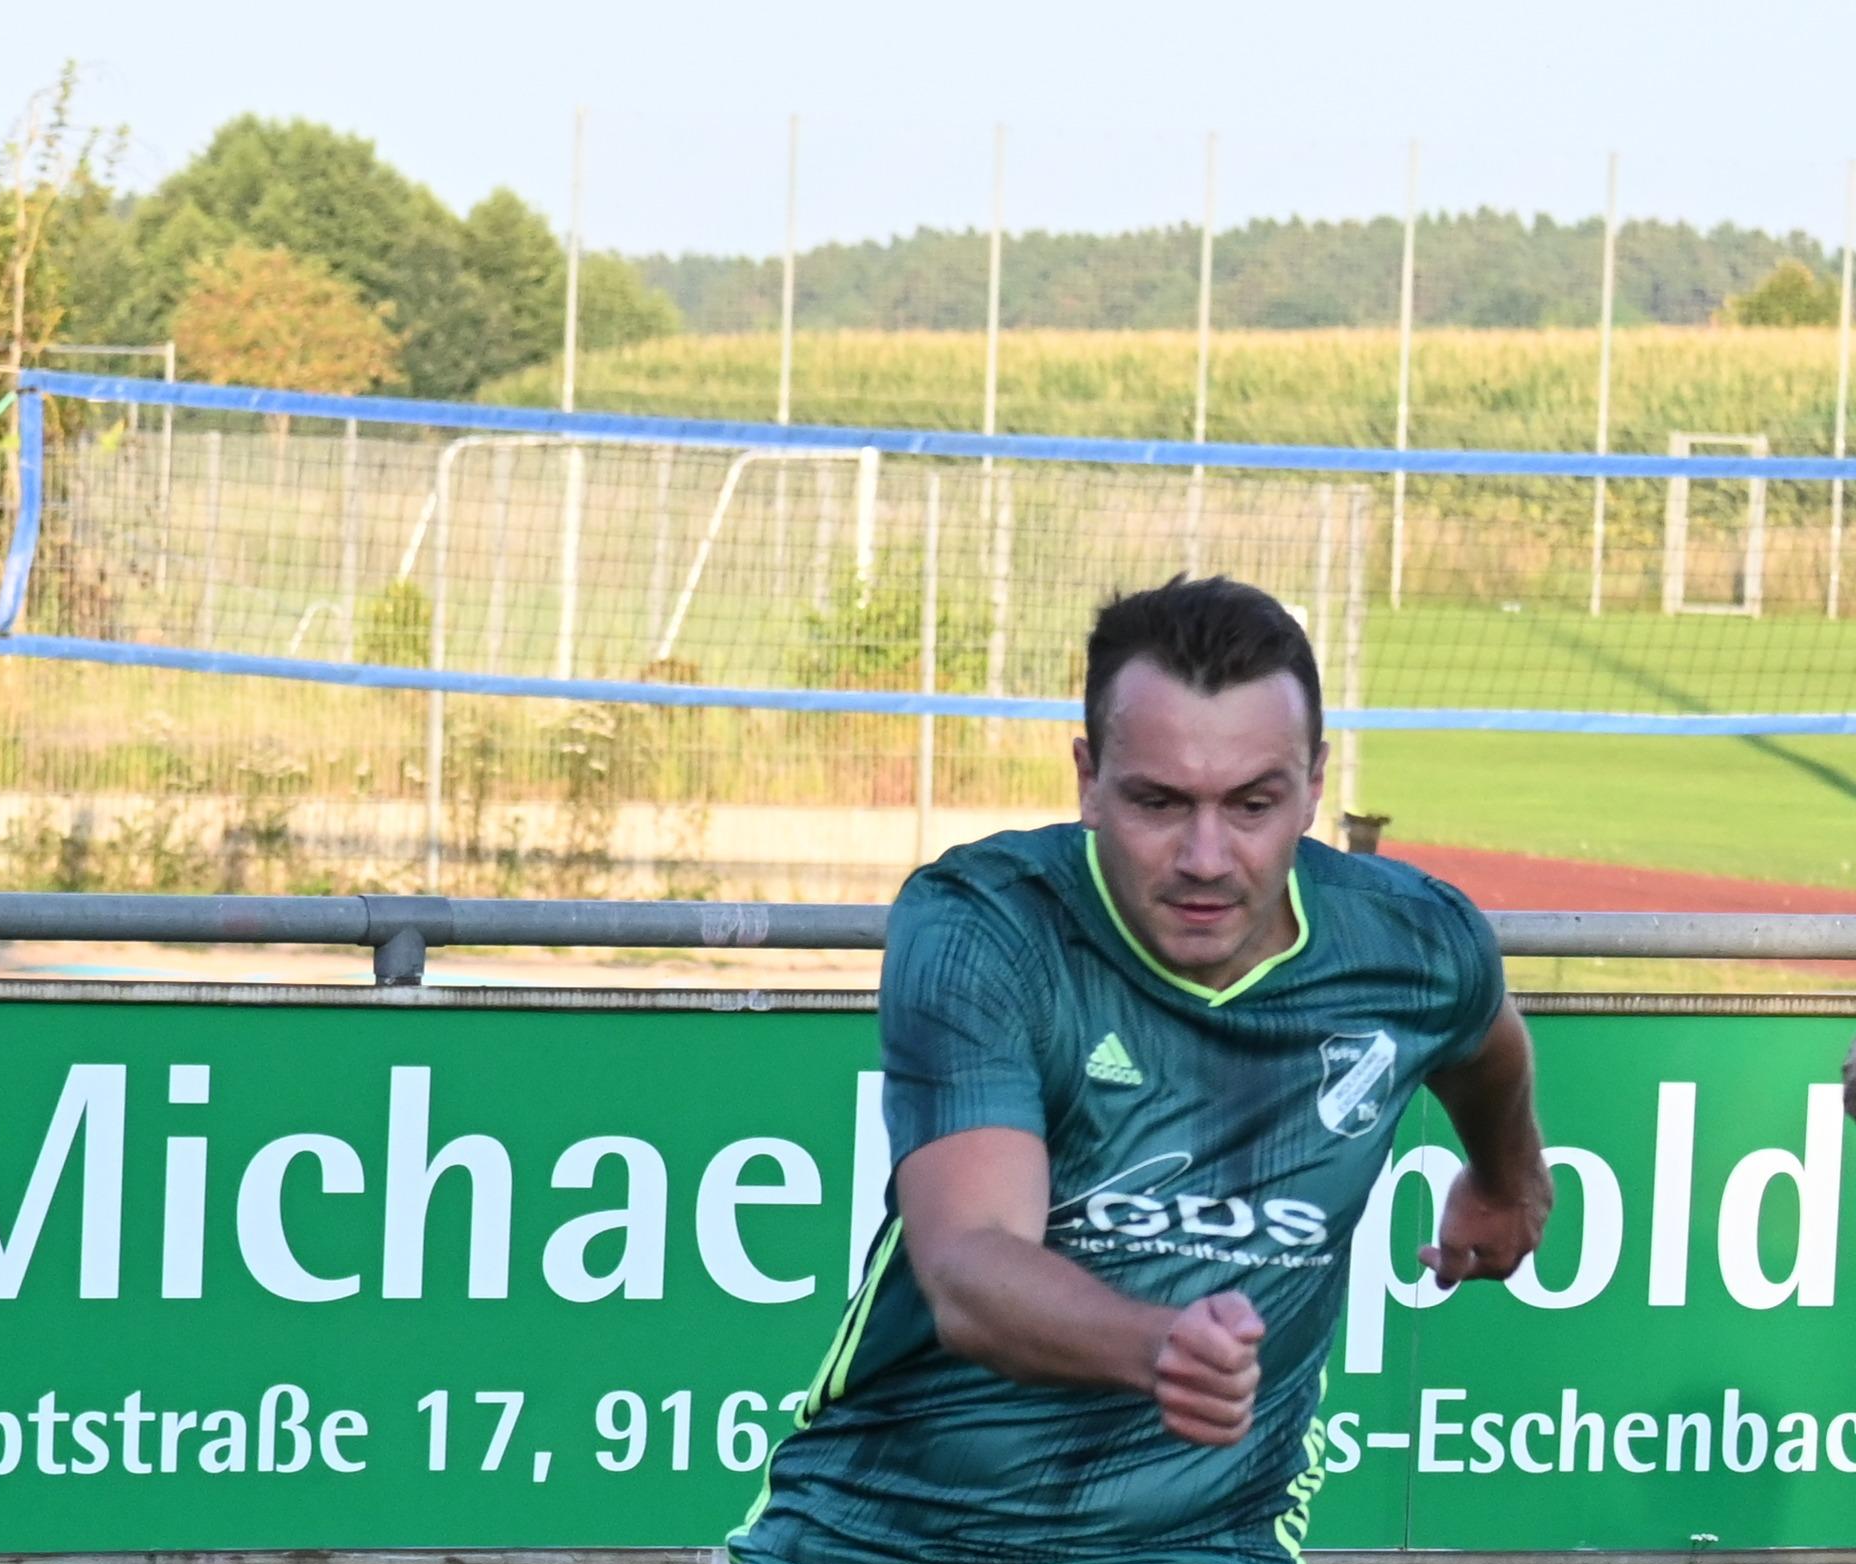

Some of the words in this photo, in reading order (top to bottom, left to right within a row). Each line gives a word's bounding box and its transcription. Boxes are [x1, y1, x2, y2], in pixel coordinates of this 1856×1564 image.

[1086, 1191, 1328, 1246] GDS
[1344, 1082, 1843, 1374] pold
[418, 1390, 552, 1483] 17,
[595, 1390, 809, 1473] 916
